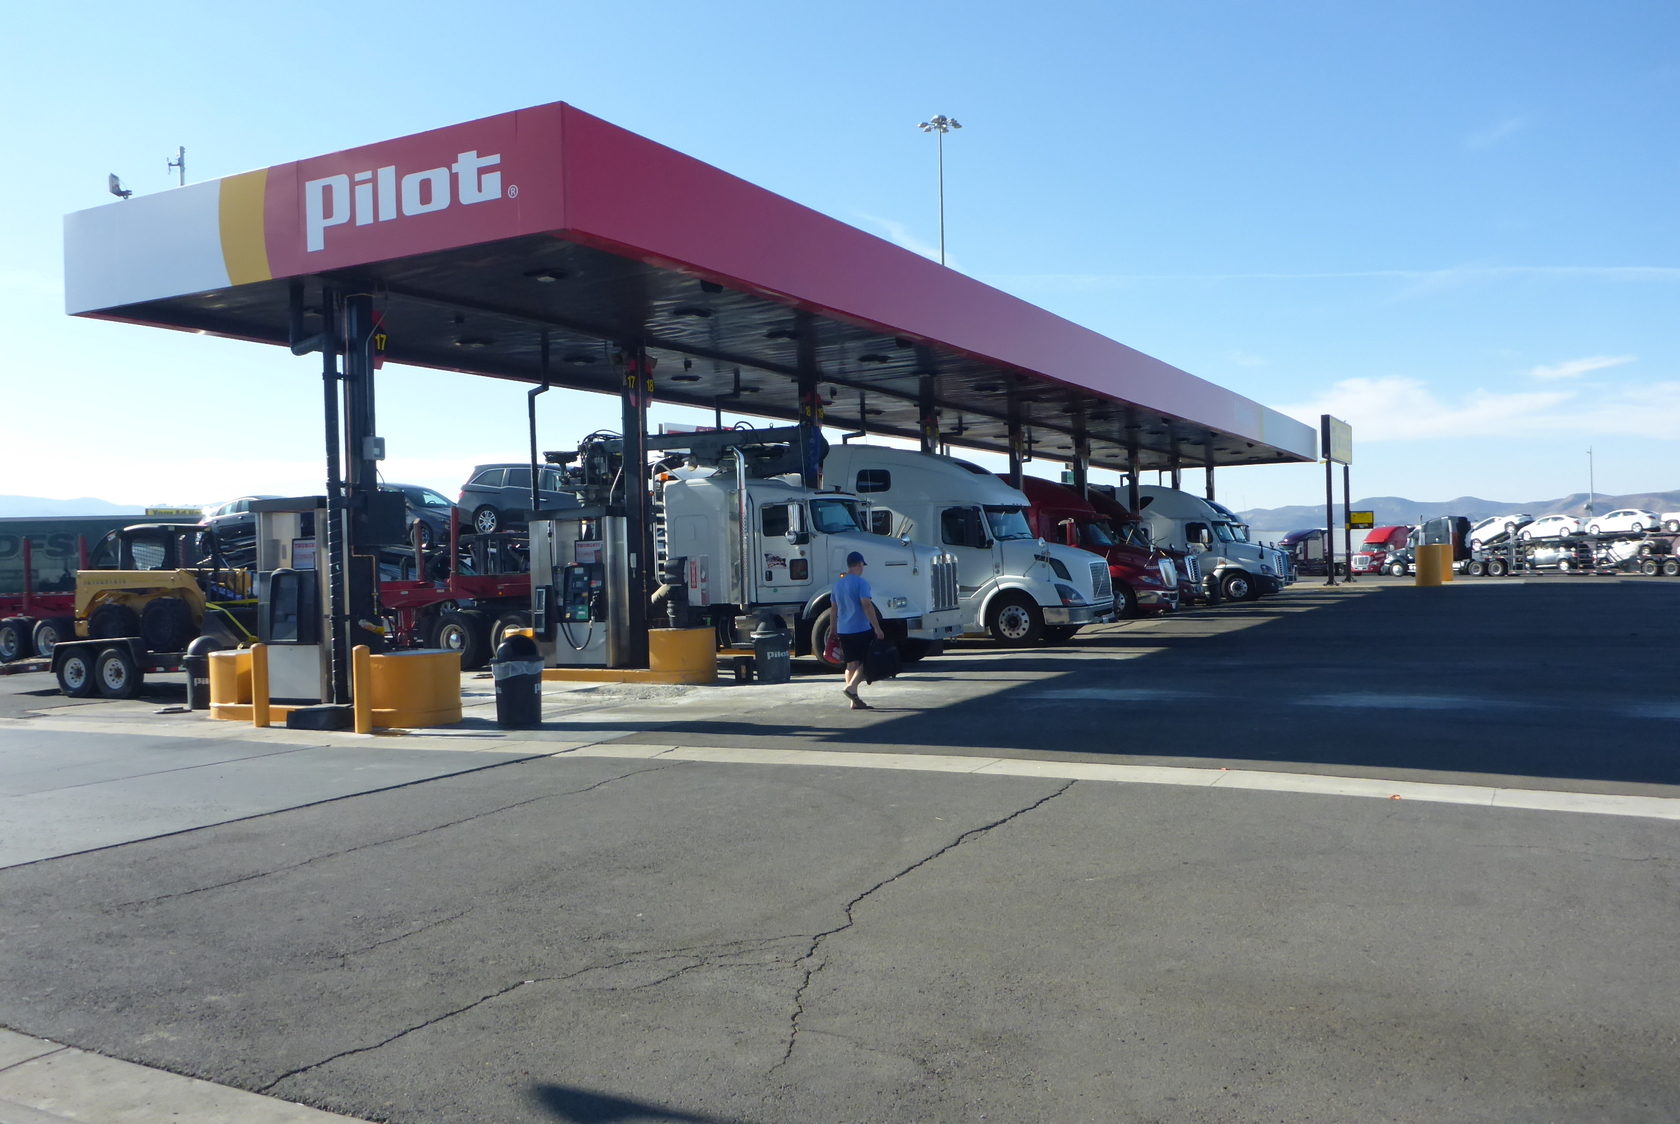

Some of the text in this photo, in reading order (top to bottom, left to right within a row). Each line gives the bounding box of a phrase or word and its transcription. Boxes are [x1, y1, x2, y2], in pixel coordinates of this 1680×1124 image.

[375, 333, 387, 351] 17
[627, 375, 636, 389] 17
[646, 379, 654, 393] 18
